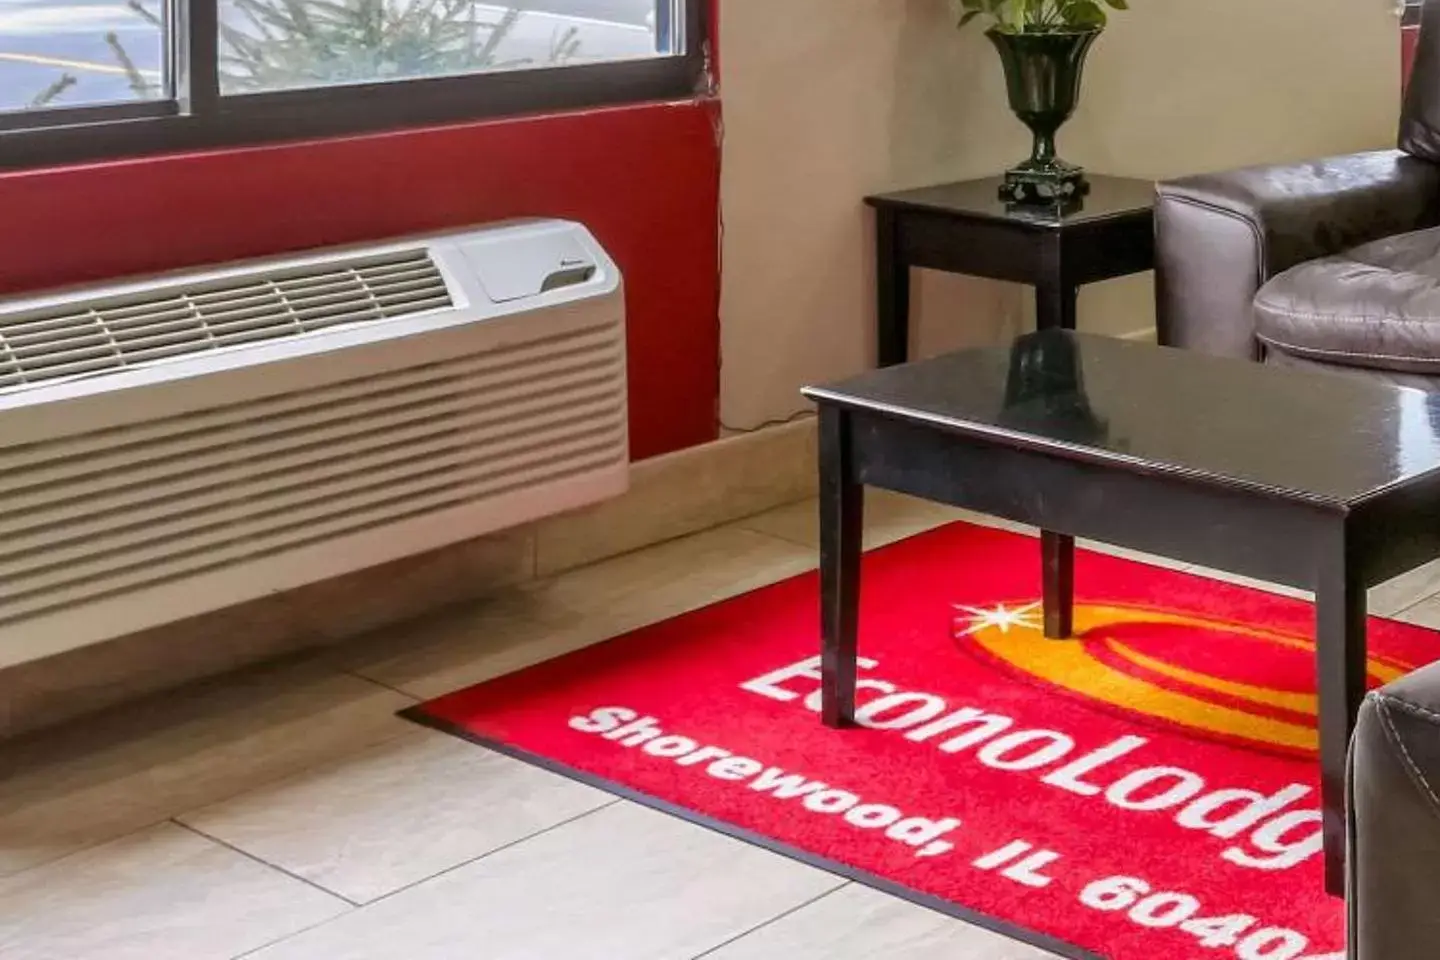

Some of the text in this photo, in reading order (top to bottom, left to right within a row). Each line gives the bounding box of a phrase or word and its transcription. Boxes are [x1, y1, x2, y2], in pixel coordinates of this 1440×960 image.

[567, 706, 1347, 960] Shorewood, IL 6040
[739, 654, 1324, 869] EconoLodg
